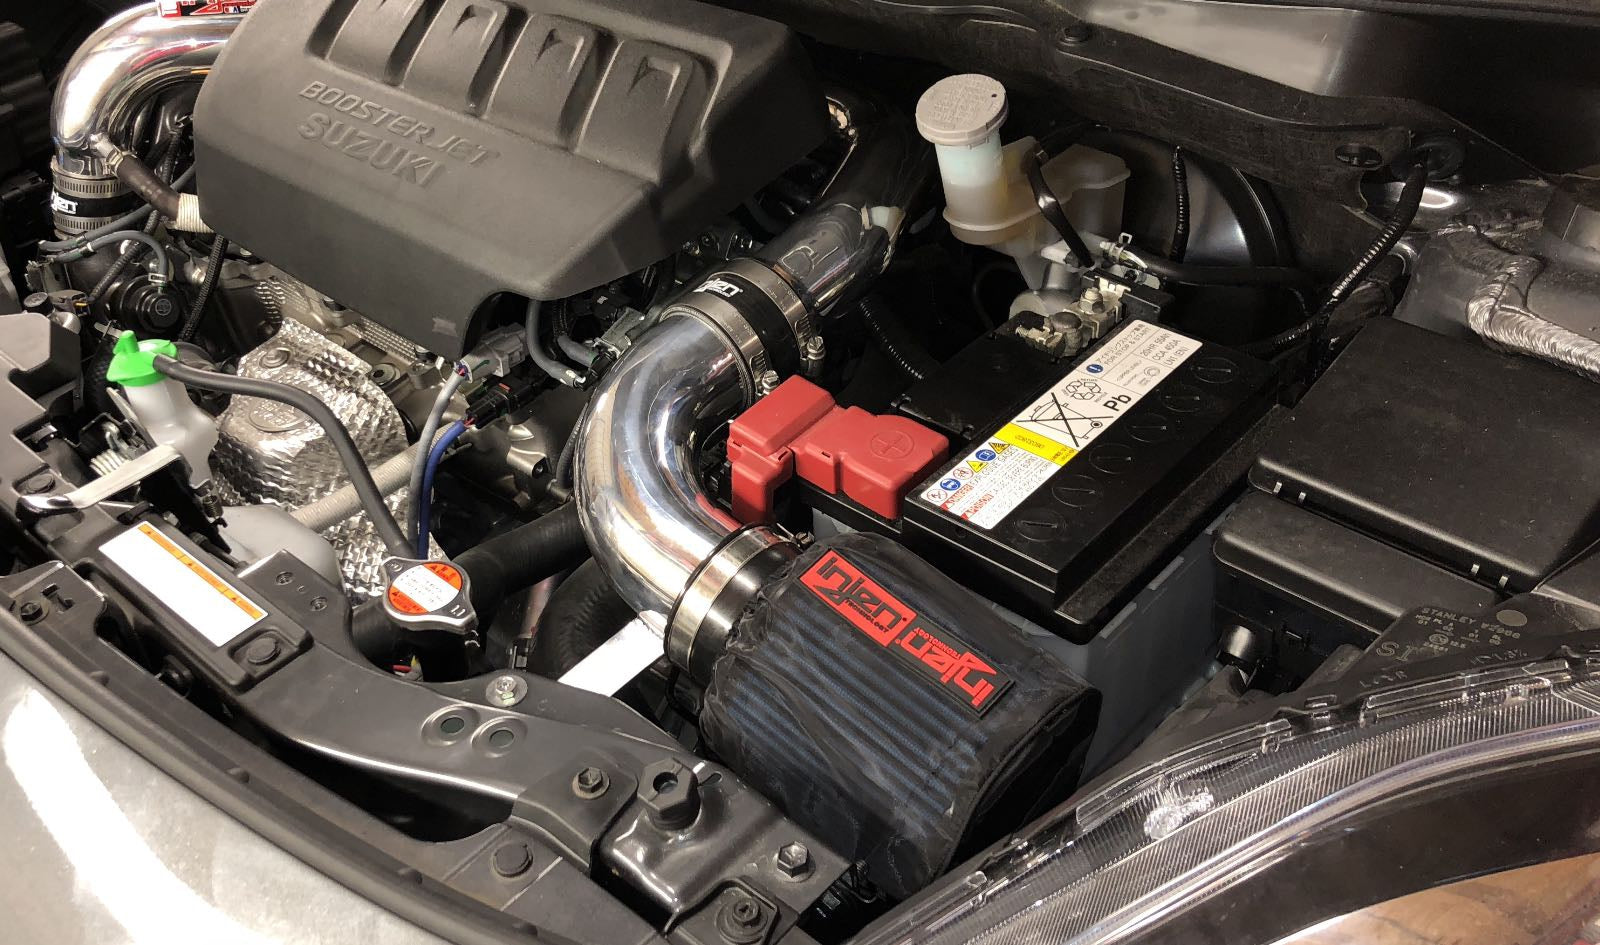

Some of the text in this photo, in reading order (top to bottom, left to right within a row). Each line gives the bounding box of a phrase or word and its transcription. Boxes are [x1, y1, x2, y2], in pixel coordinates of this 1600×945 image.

[298, 112, 446, 188] SUZUKI
[1150, 349, 1168, 361] CCA
[1102, 391, 1133, 411] Pb
[845, 597, 889, 633] TECHNOLOGY
[1422, 608, 1476, 624] STANLEY
